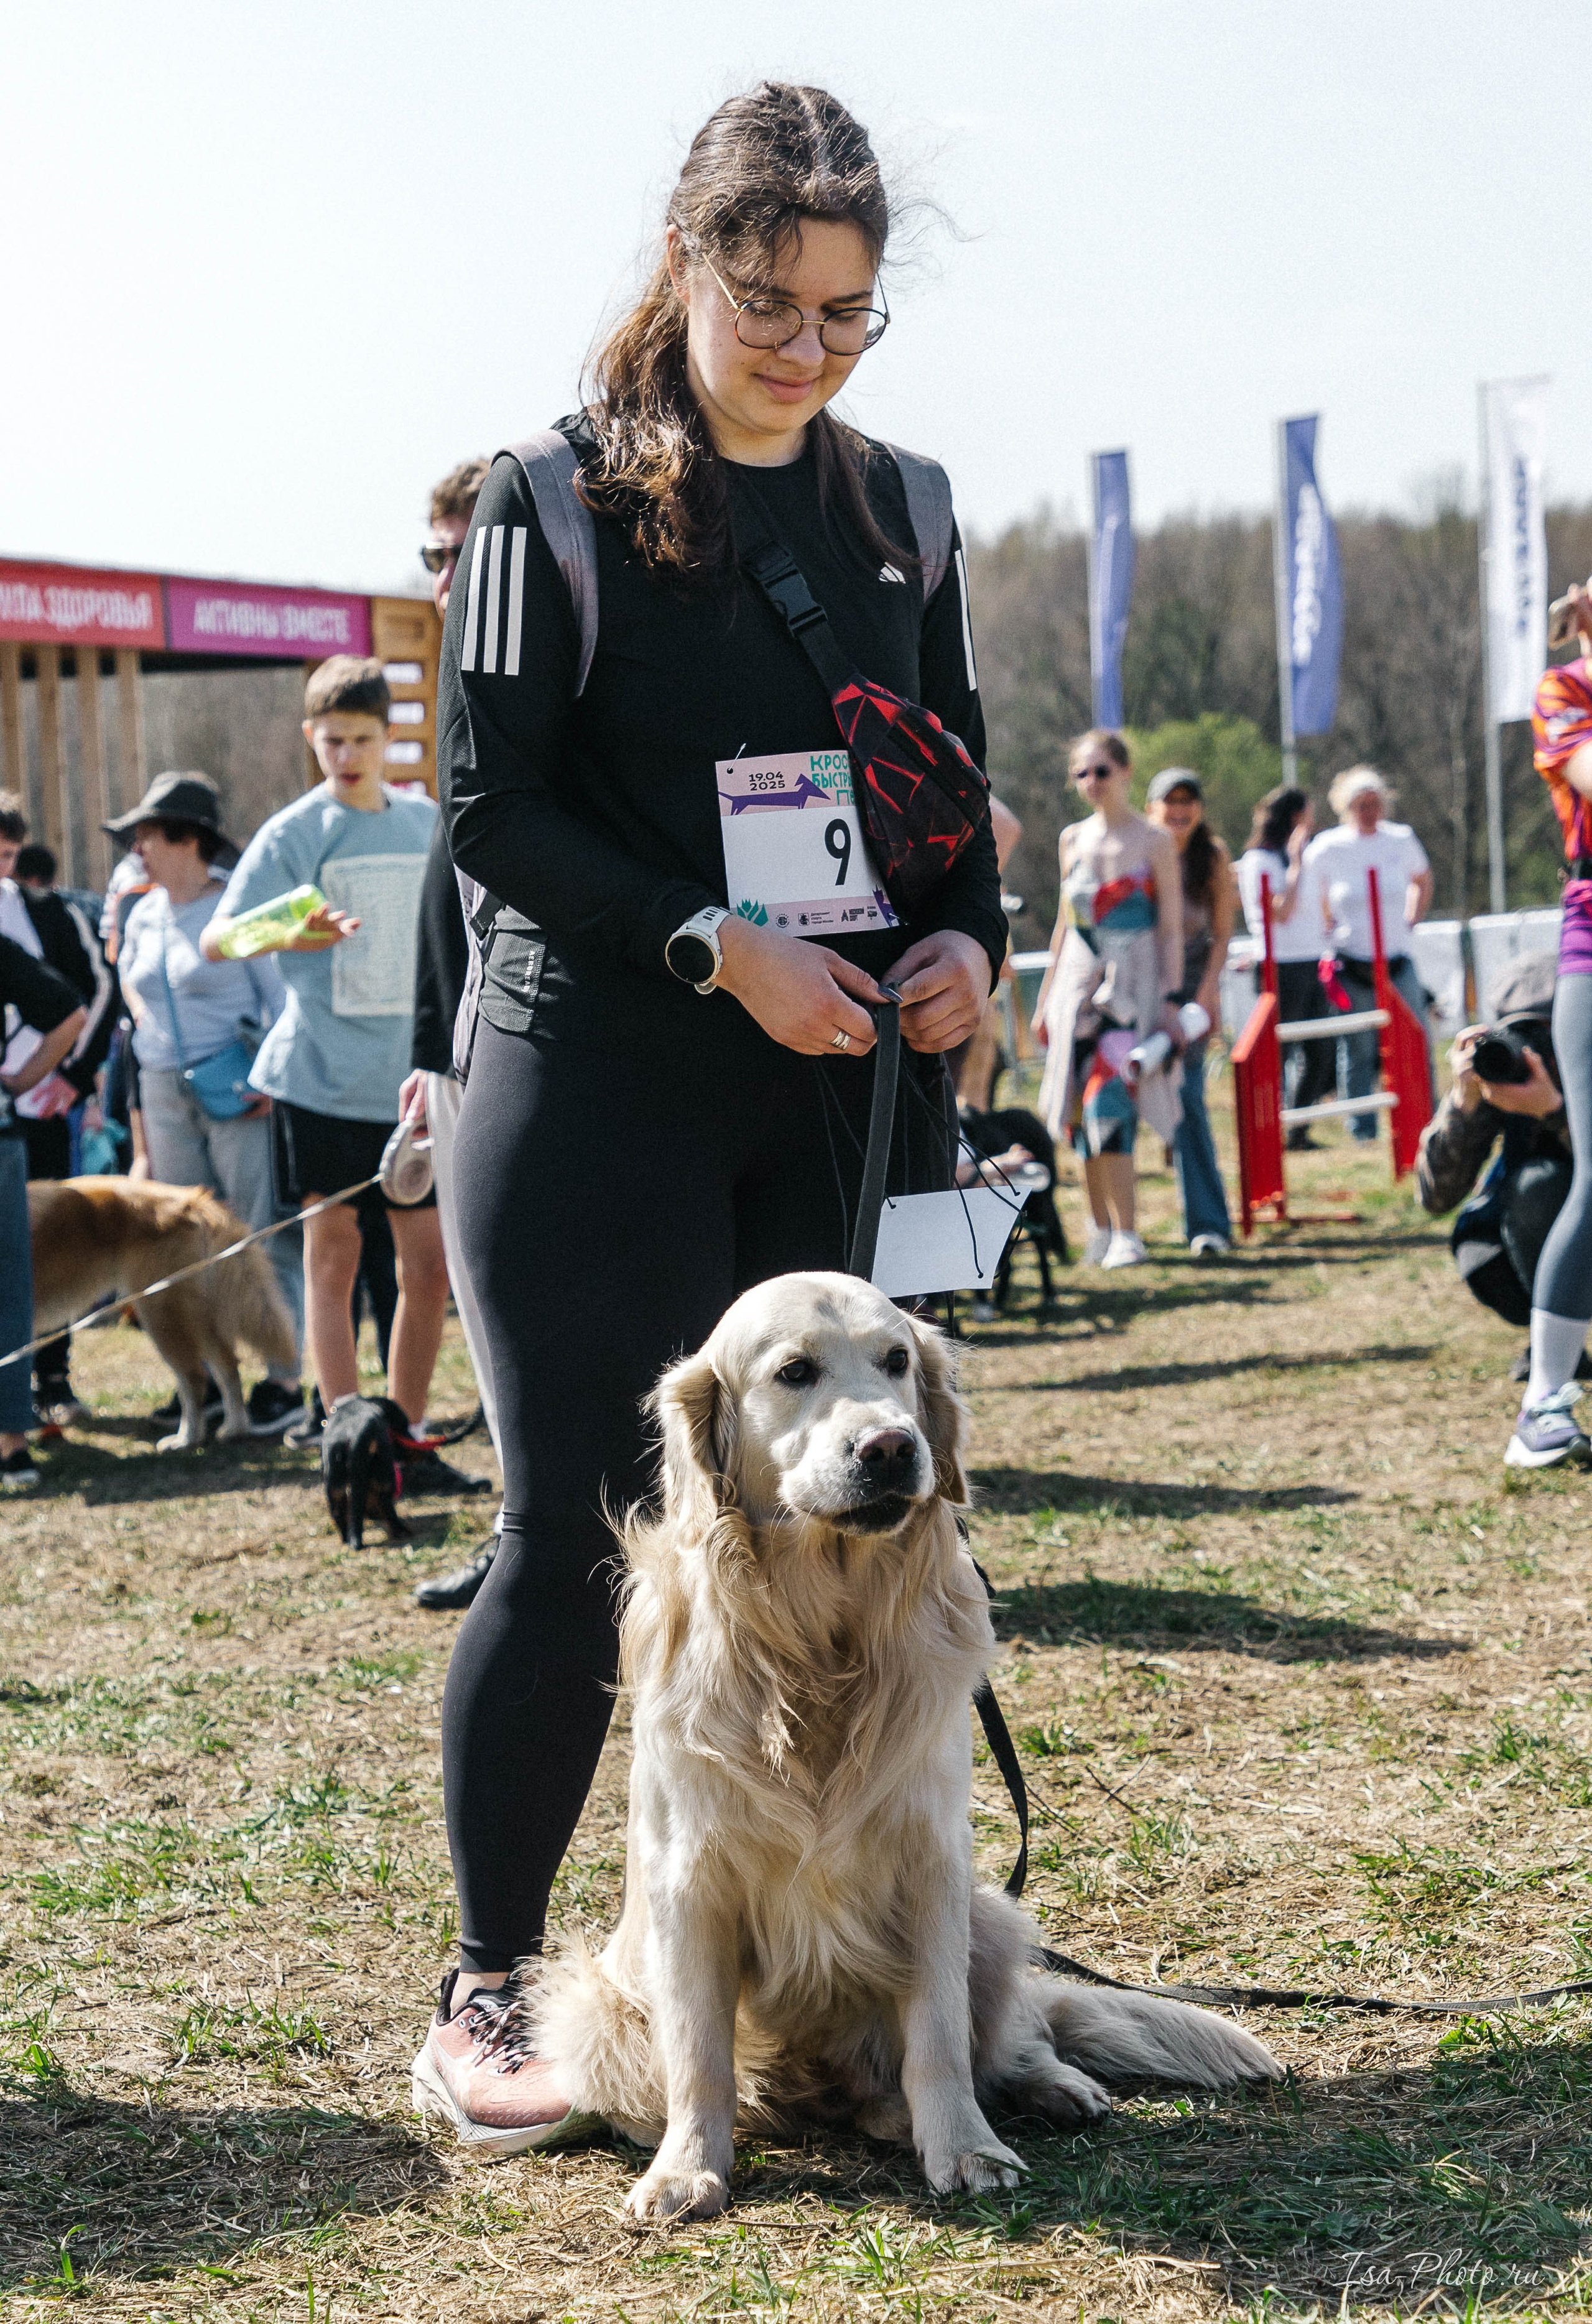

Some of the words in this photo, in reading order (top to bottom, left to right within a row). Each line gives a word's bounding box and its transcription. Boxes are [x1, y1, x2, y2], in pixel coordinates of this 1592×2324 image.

[749, 771, 784, 782] 19.04
[750, 780, 785, 791] 2025
[825, 818, 851, 886] 9
